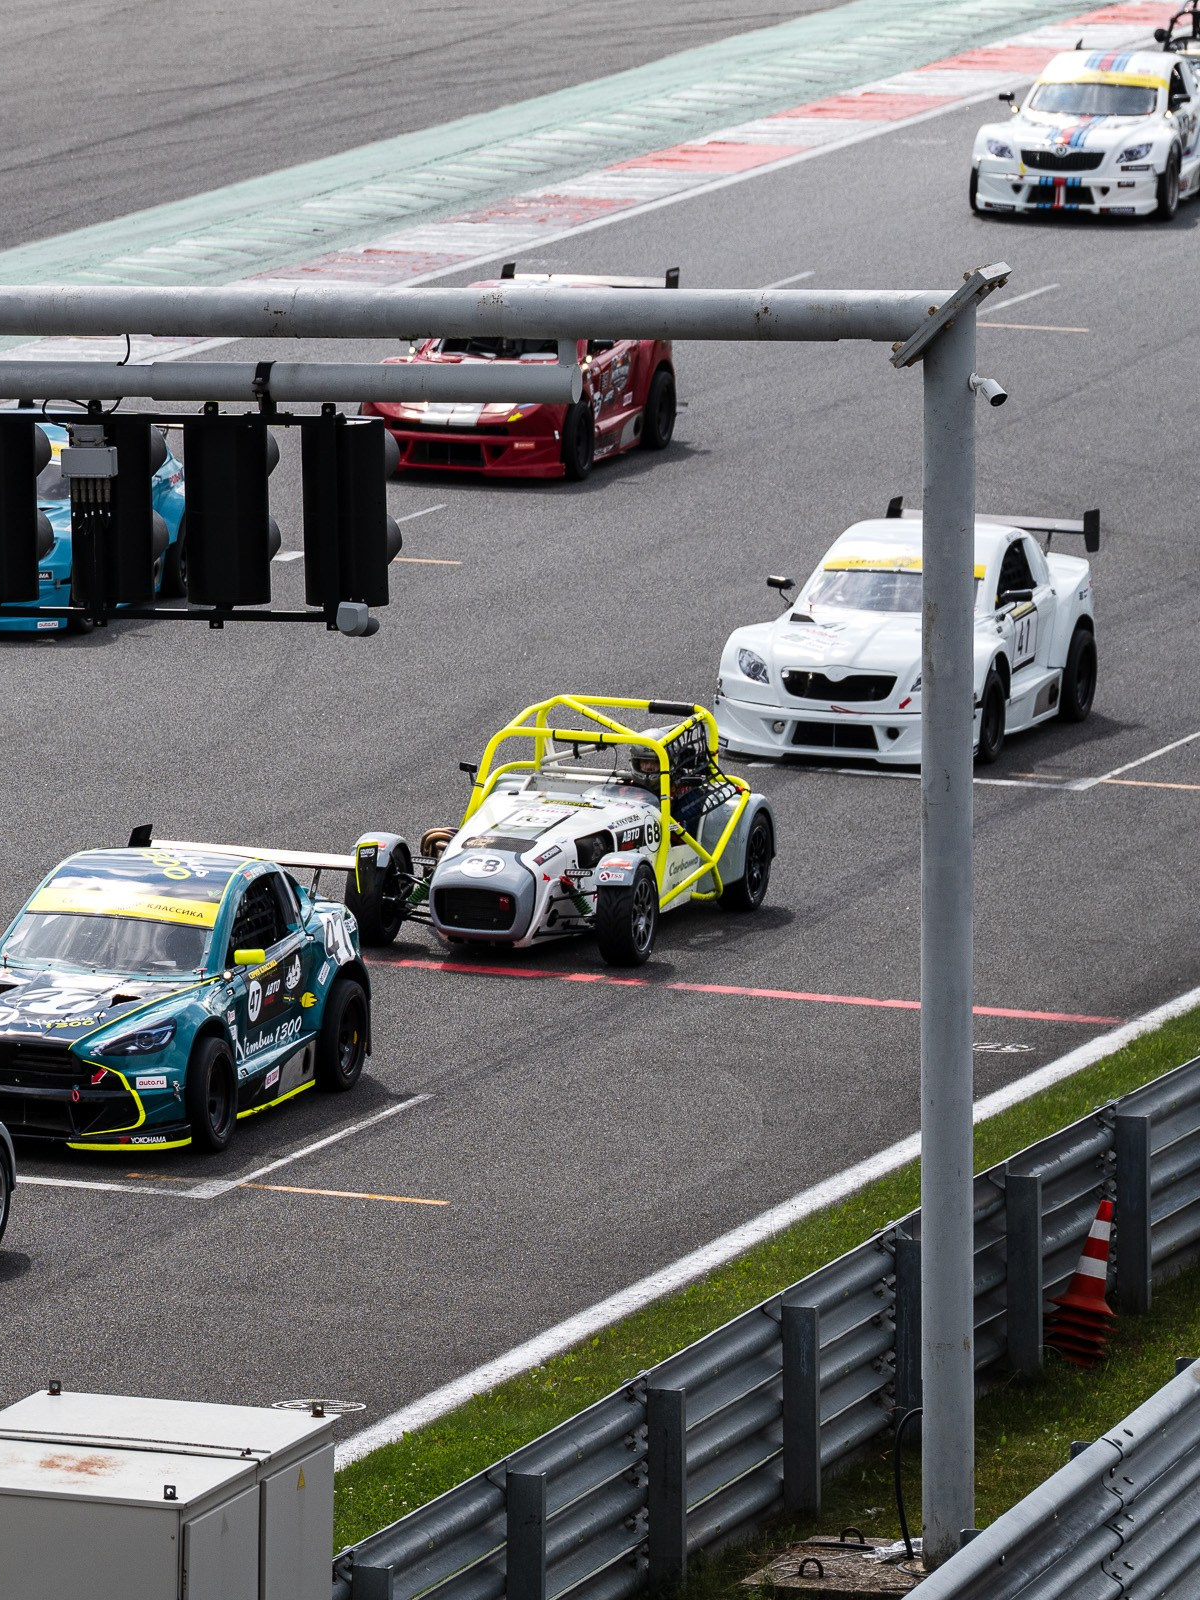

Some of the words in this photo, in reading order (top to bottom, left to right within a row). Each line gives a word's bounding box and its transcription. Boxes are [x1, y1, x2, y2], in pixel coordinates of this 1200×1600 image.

[622, 828, 640, 844] АВТО
[646, 822, 660, 843] 68
[467, 858, 500, 872] 68
[146, 903, 204, 919] КЛАССИКА
[326, 912, 352, 964] 47
[250, 990, 261, 1013] 47
[235, 1031, 274, 1062] Nimbus
[275, 1016, 302, 1042] 1300
